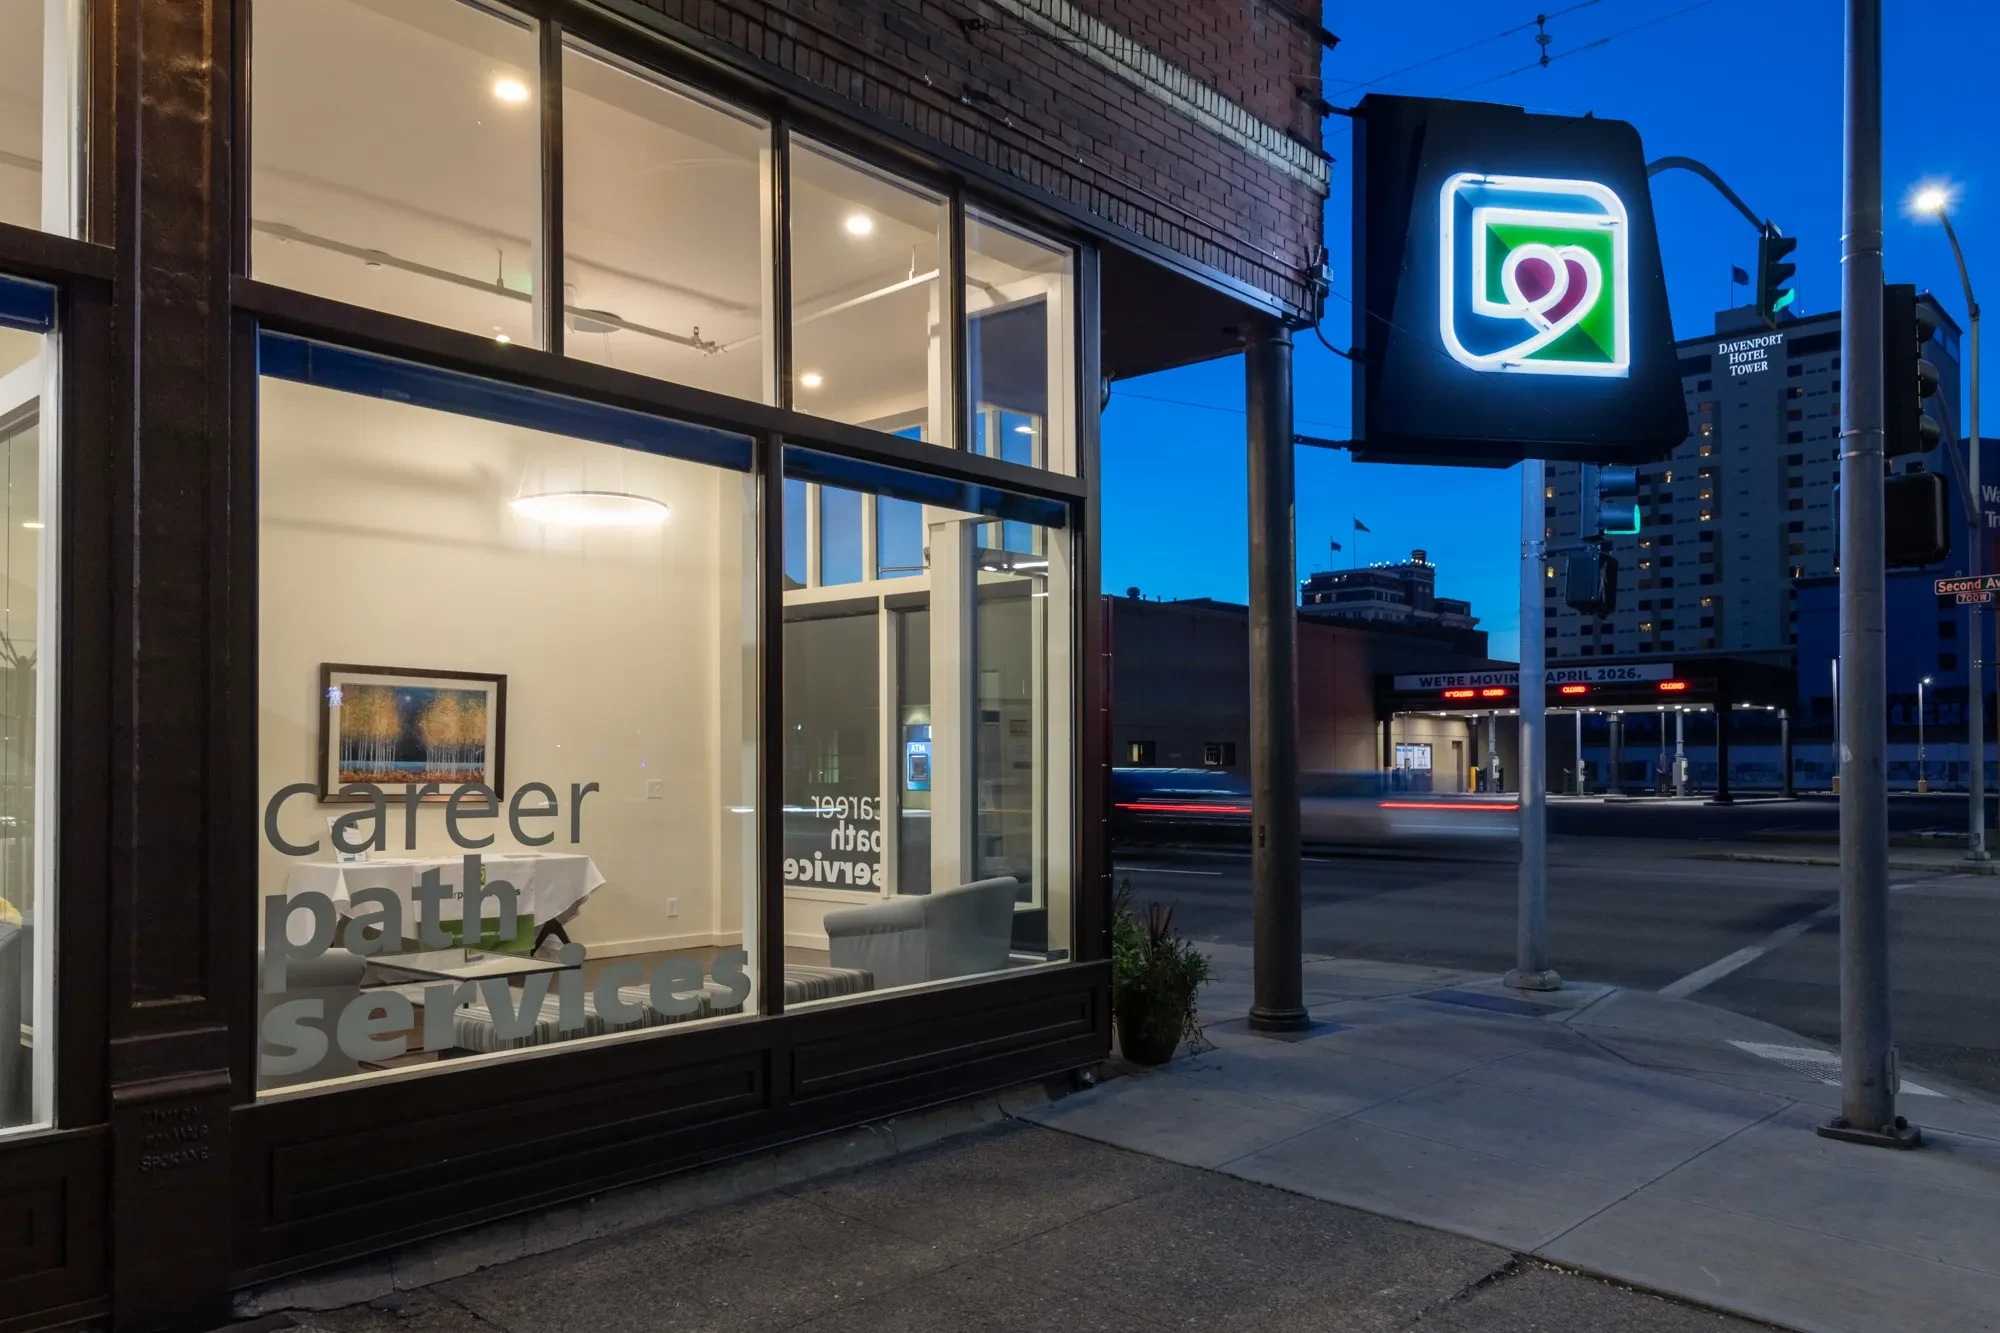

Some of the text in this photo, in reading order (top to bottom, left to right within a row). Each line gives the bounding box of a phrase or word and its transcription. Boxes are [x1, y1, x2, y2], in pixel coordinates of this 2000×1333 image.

[1718, 333, 1784, 355] DAVENPORT
[1728, 349, 1768, 365] HOTEL
[1728, 360, 1769, 377] TOWER
[1938, 578, 1981, 593] Second
[1419, 667, 1642, 688] WE'RE MOVIN APRIL 2026.
[911, 744, 926, 753] ATM
[264, 780, 600, 856] career
[264, 854, 518, 994] path
[261, 942, 752, 1075] services
